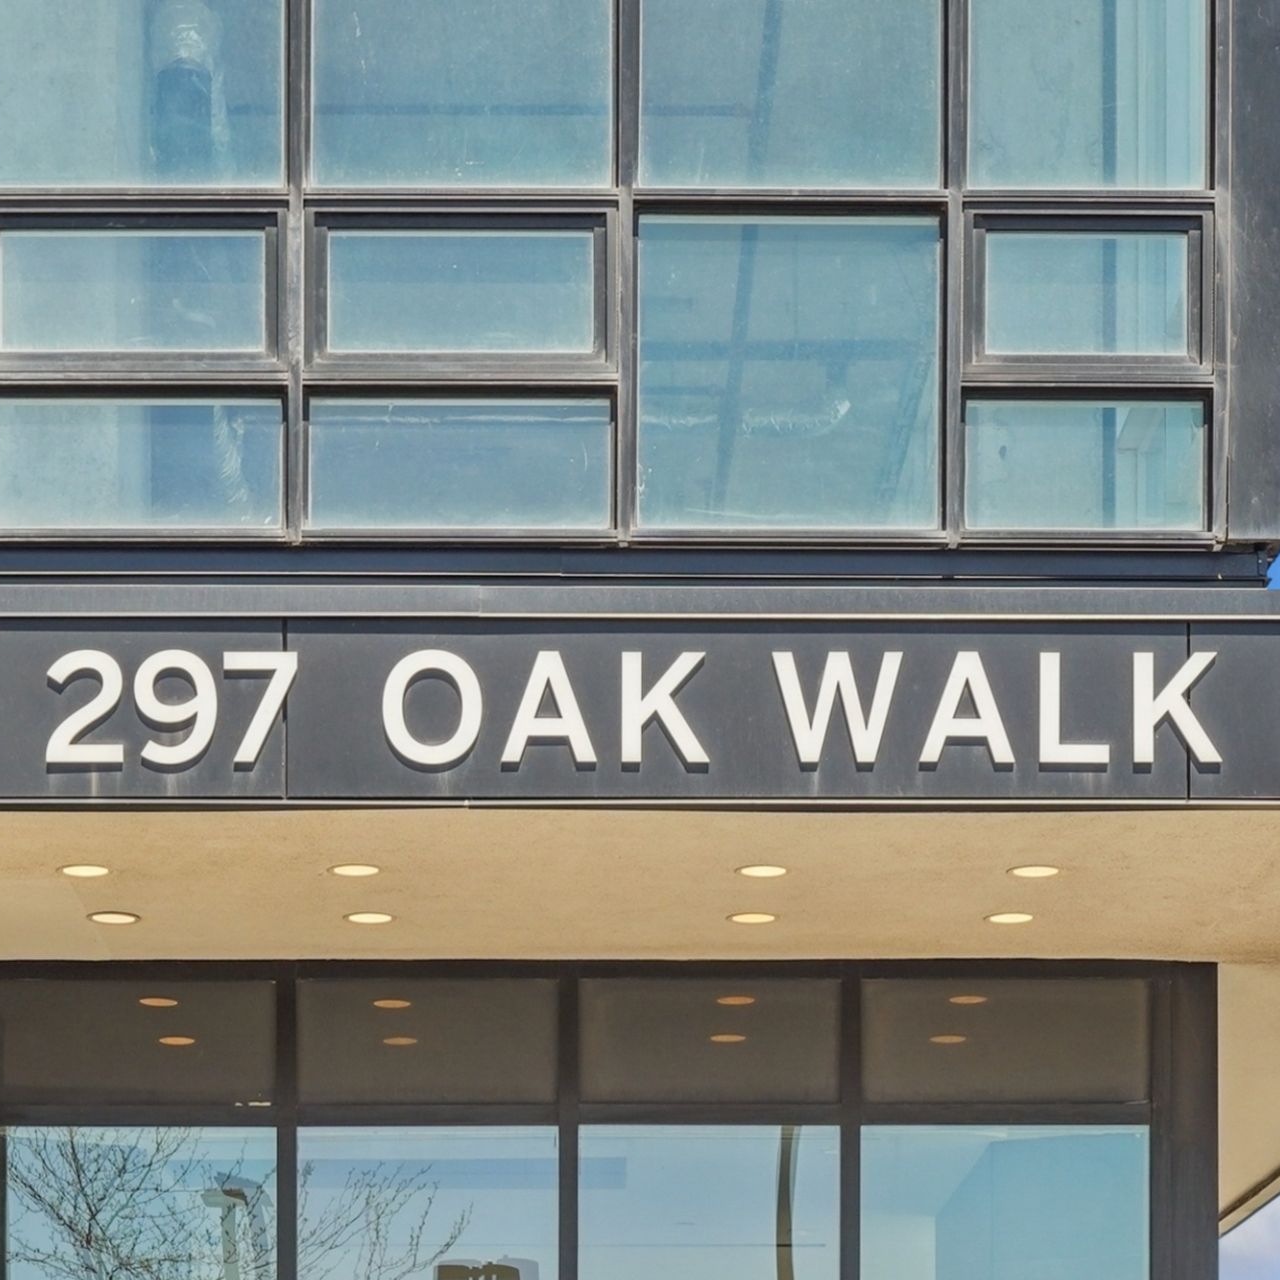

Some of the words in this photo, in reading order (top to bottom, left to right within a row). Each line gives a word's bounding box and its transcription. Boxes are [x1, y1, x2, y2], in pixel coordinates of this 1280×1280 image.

[46, 649, 298, 768] 297
[382, 649, 710, 768] OAK
[771, 650, 1223, 770] WALK
